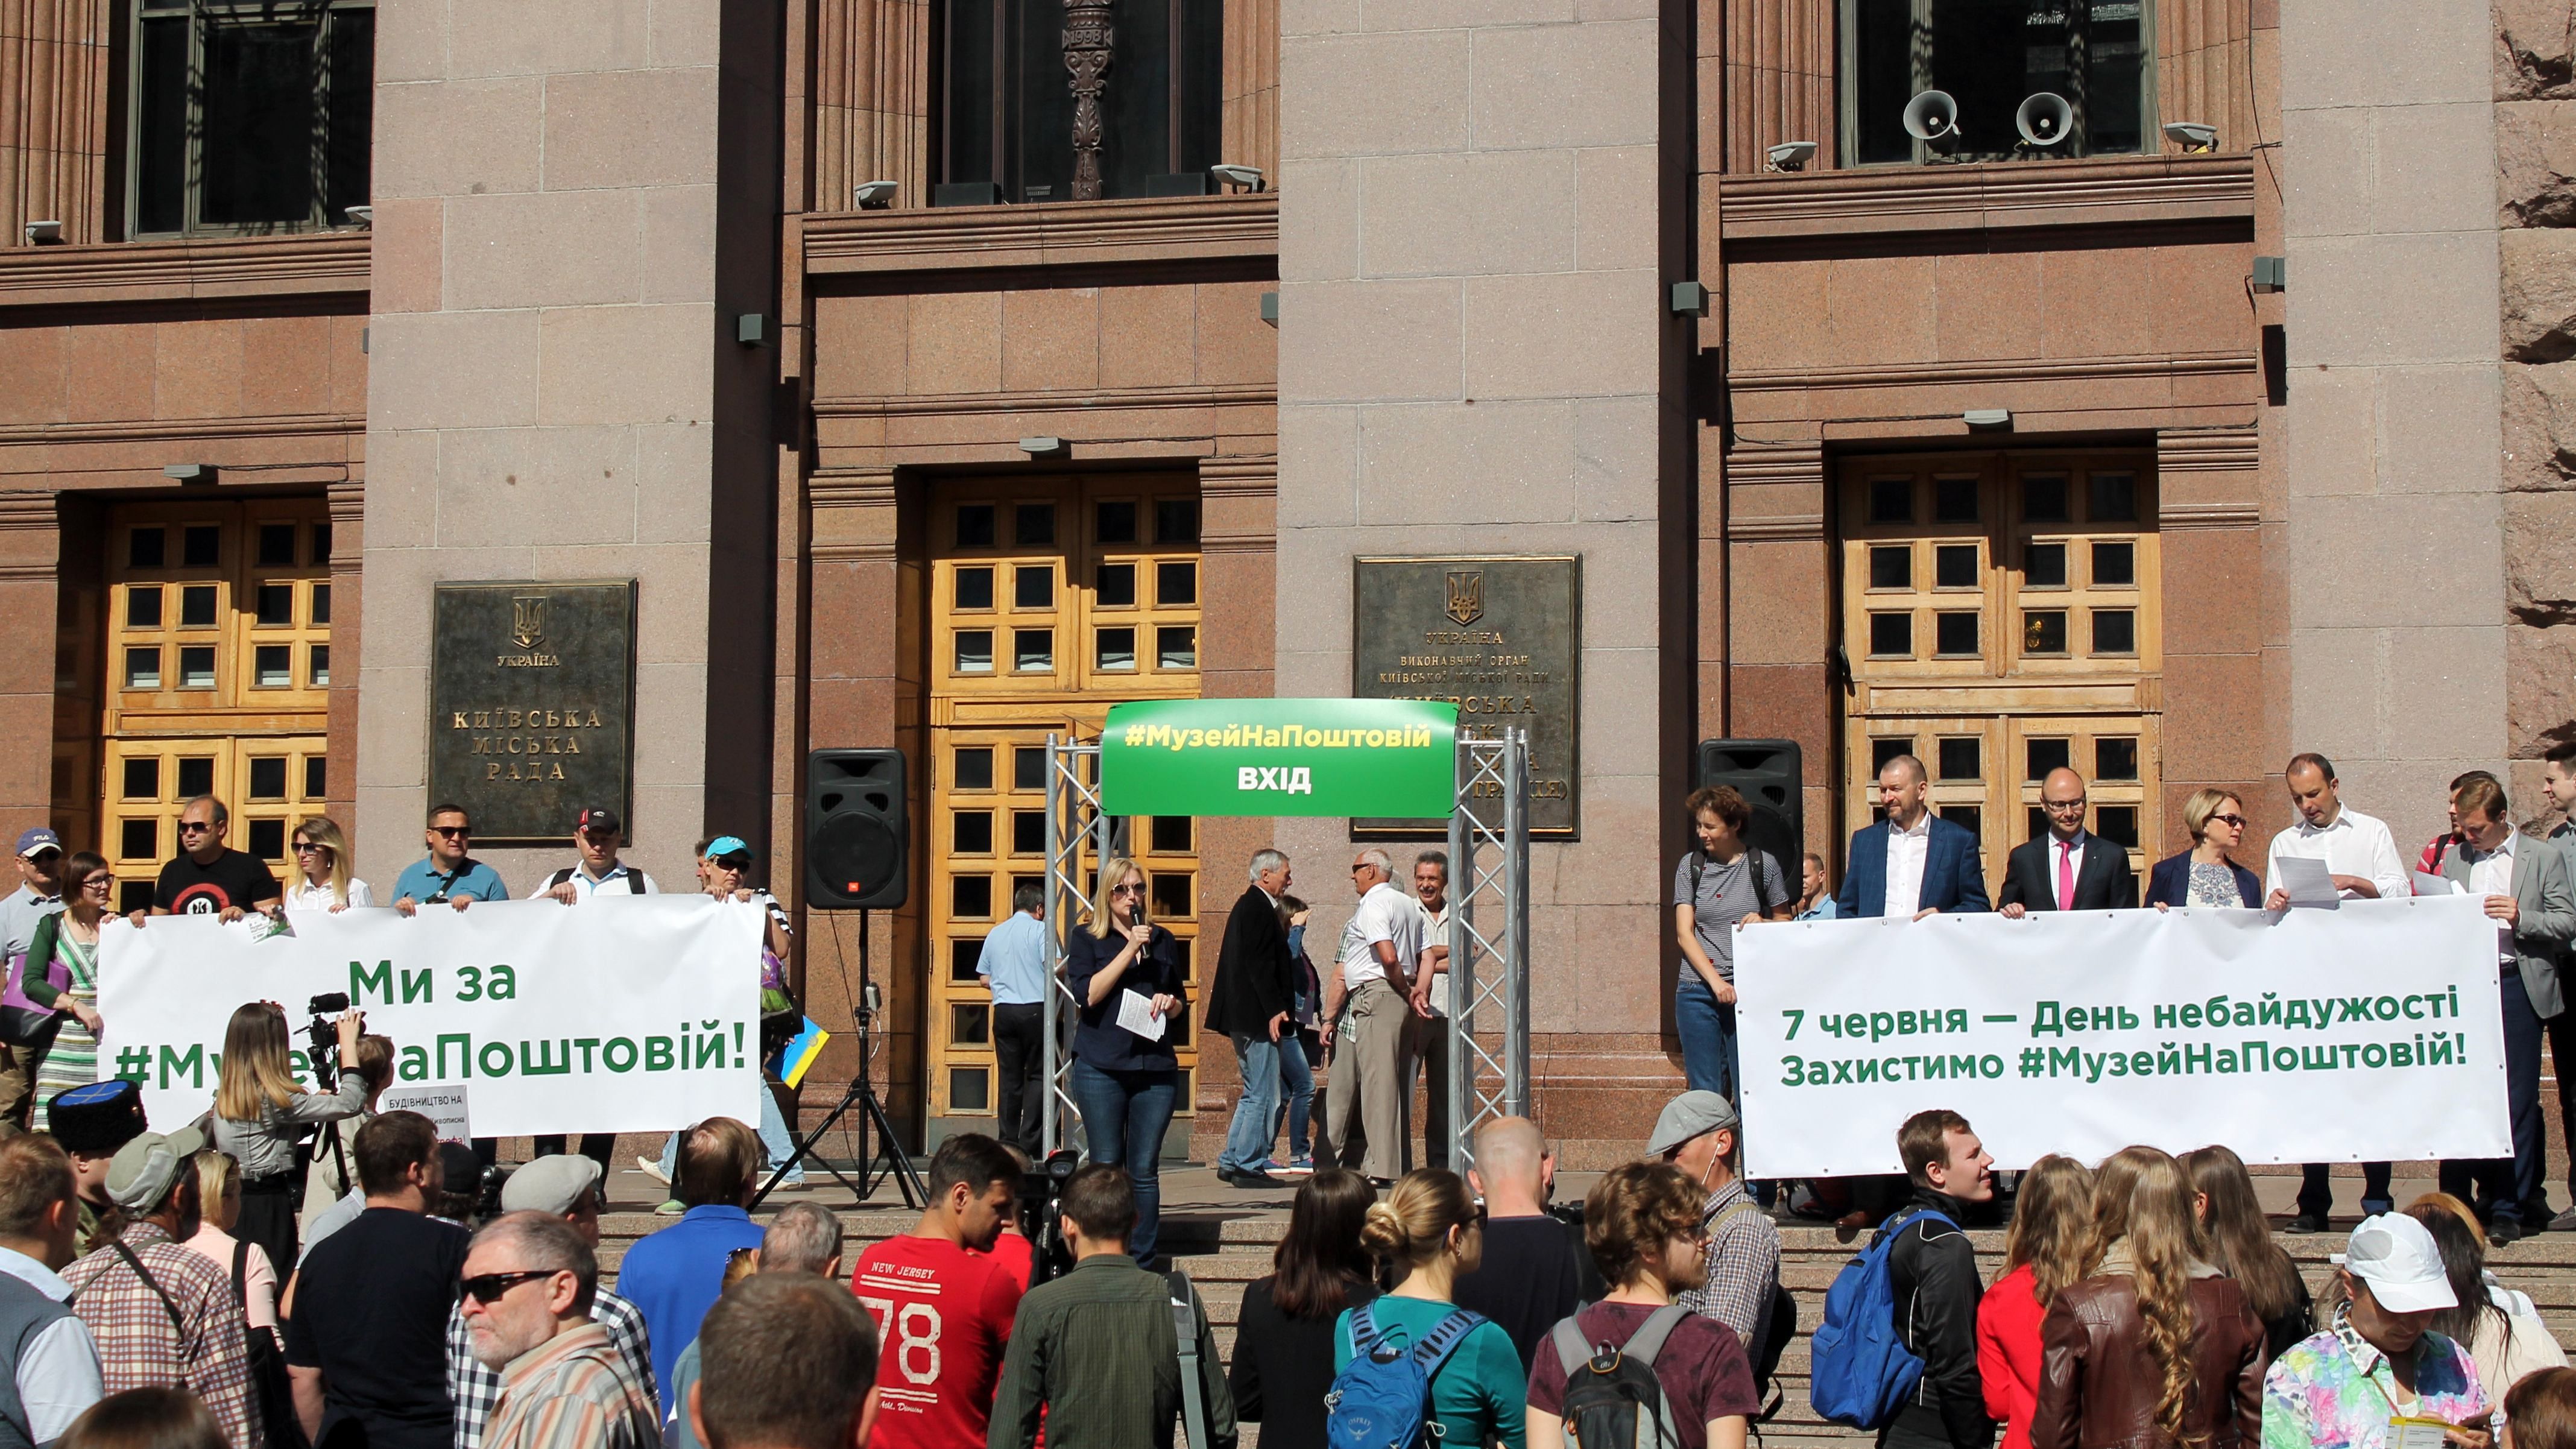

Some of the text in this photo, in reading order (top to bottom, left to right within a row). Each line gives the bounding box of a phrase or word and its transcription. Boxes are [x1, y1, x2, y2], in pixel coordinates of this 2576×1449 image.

[1070, 30, 1102, 44] 1998
[1425, 631, 1503, 645] УКРАЇНА
[497, 653, 560, 668] УКРАЇНА
[1401, 654, 1529, 667] ВИКОНАВЧИЙ ОРГАН
[1380, 670, 1549, 684] КИЇВСЬКОЇ МІСЬКОЇ РАДИ
[453, 708, 601, 729] КИЇВСЬКА
[471, 736, 580, 755] МІСЬКА
[1125, 724, 1431, 751] #МузейНаПоштовій
[487, 762, 565, 782] РАДА
[1238, 766, 1312, 795] ВХІД
[349, 960, 516, 1007] Ми за
[1782, 1009, 1805, 1041] 7
[1820, 1008, 1968, 1044] червня
[2031, 1000, 2140, 1038] День
[2153, 985, 2460, 1031] небайдужості
[1782, 1032, 2467, 1087] Захистимо #МузейНаПоштовій!
[389, 1095, 462, 1110] БУДІВНИЦТВО НА
[871, 1261, 935, 1280] NEW JERSEY
[856, 1295, 942, 1386] 78
[1348, 1417, 1371, 1427] OSPREY
